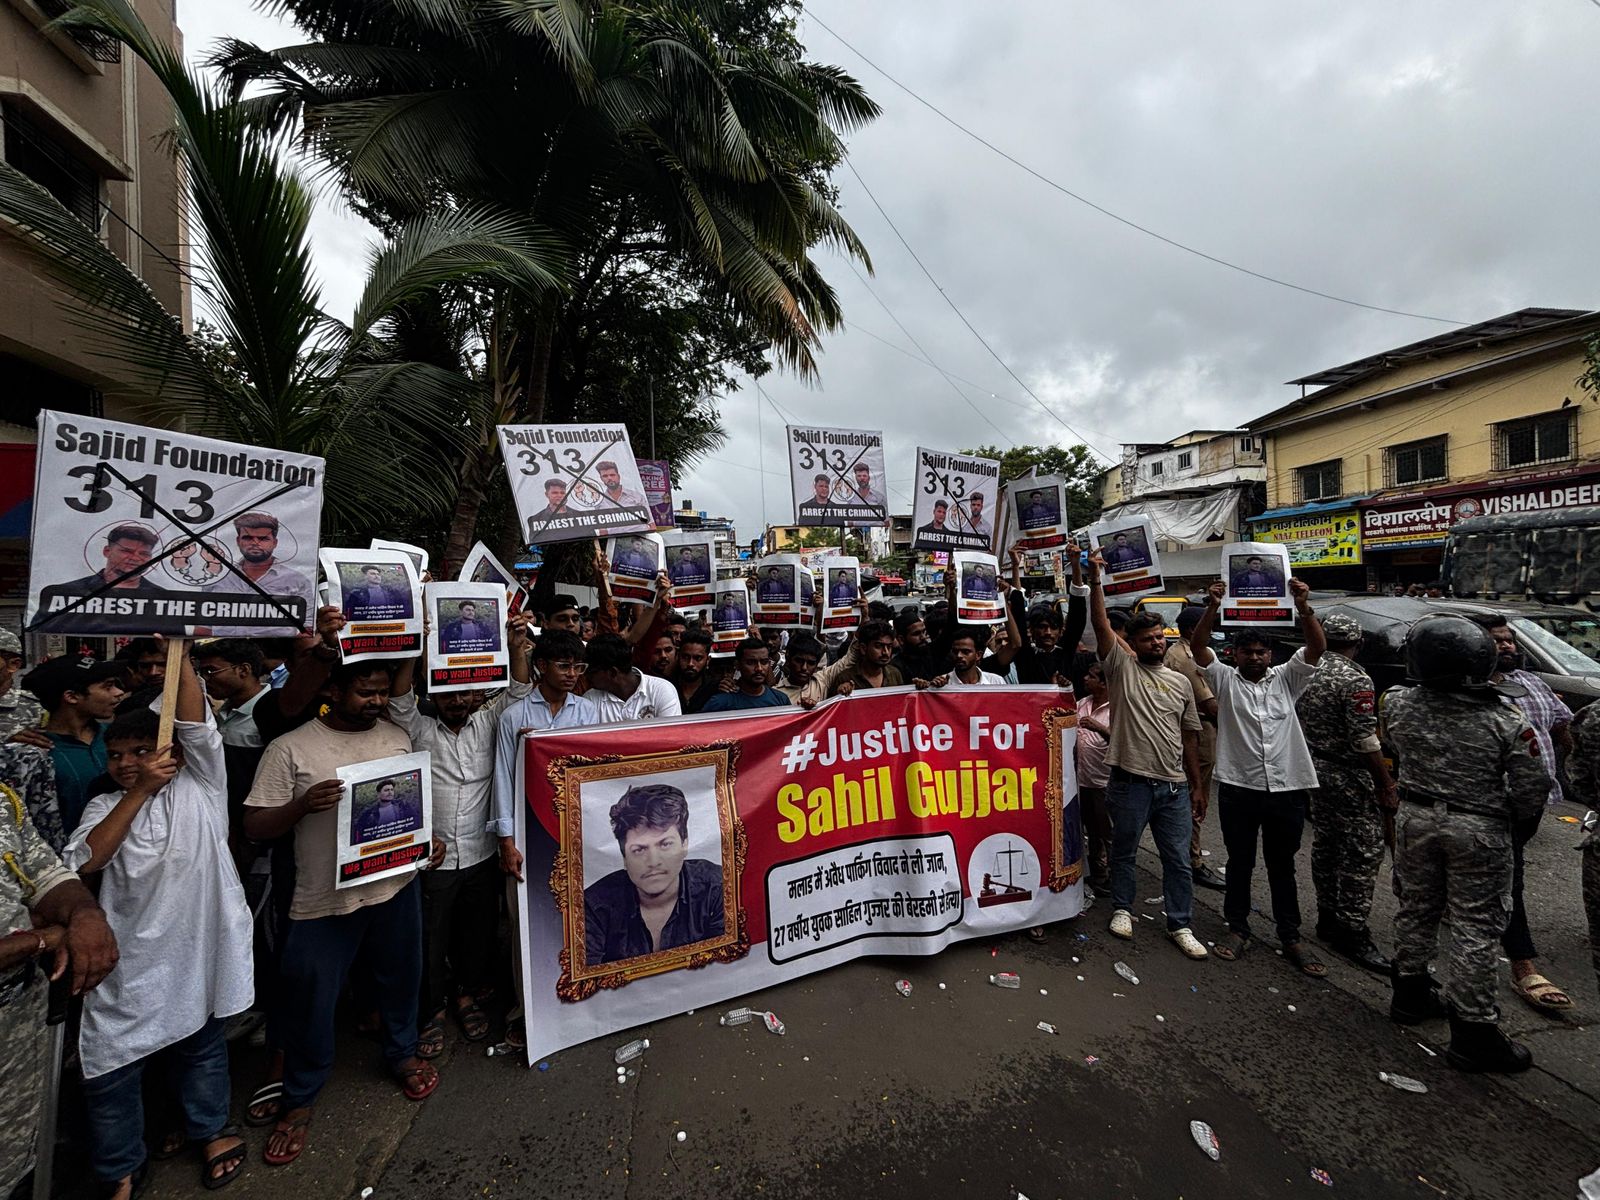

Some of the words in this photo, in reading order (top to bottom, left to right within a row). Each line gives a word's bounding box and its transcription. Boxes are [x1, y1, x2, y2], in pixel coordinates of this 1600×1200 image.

[506, 429, 546, 446] Sajid
[548, 428, 626, 445] Foundation
[823, 431, 880, 448] Foundation
[55, 423, 146, 462] Sajid
[153, 439, 316, 487] Foundation
[516, 448, 586, 476] 313
[799, 447, 847, 471] 313
[922, 452, 947, 468] Sajid
[949, 459, 998, 478] Foundation
[643, 481, 666, 489] REE
[924, 472, 965, 499] 313
[533, 519, 574, 532] ARREST
[576, 515, 597, 526] THE
[599, 510, 647, 524] CRIMINAL
[802, 508, 831, 517] ARREST
[832, 509, 847, 517] THE
[848, 509, 883, 518] CRIMINAL
[1364, 501, 1452, 528] विशालदीप
[918, 531, 944, 542] ARREST
[945, 534, 959, 544] THE
[1273, 533, 1293, 541] NAAZ
[1295, 527, 1333, 540] TELECOM
[48, 594, 149, 617] ARREST
[153, 600, 196, 617] THE
[201, 602, 300, 619] CRIMINAL
[354, 637, 377, 647] want
[380, 635, 414, 646] Justice
[434, 670, 448, 680] We
[450, 670, 470, 679] want
[472, 667, 502, 678] Justice
[781, 718, 953, 774] #Justice
[969, 716, 1029, 751] For
[776, 766, 896, 843] Sahil
[905, 760, 1037, 819] Gujjar
[344, 862, 359, 875] We
[362, 855, 387, 869] want
[389, 845, 423, 863] Justice
[787, 876, 813, 899] मलाड
[814, 866, 823, 891] में
[825, 862, 845, 888] अवैध
[873, 852, 898, 877] विवाद
[899, 850, 910, 875] ने
[910, 849, 923, 874] ली
[924, 852, 947, 874] जान,
[774, 926, 786, 948] 27
[787, 914, 809, 943] वर्षीय
[812, 911, 833, 941] युवक
[834, 900, 862, 928] साहिल
[863, 898, 890, 926] गुज्जर
[891, 892, 905, 918] की
[906, 890, 938, 917] बेरहमी
[939, 889, 946, 914] से
